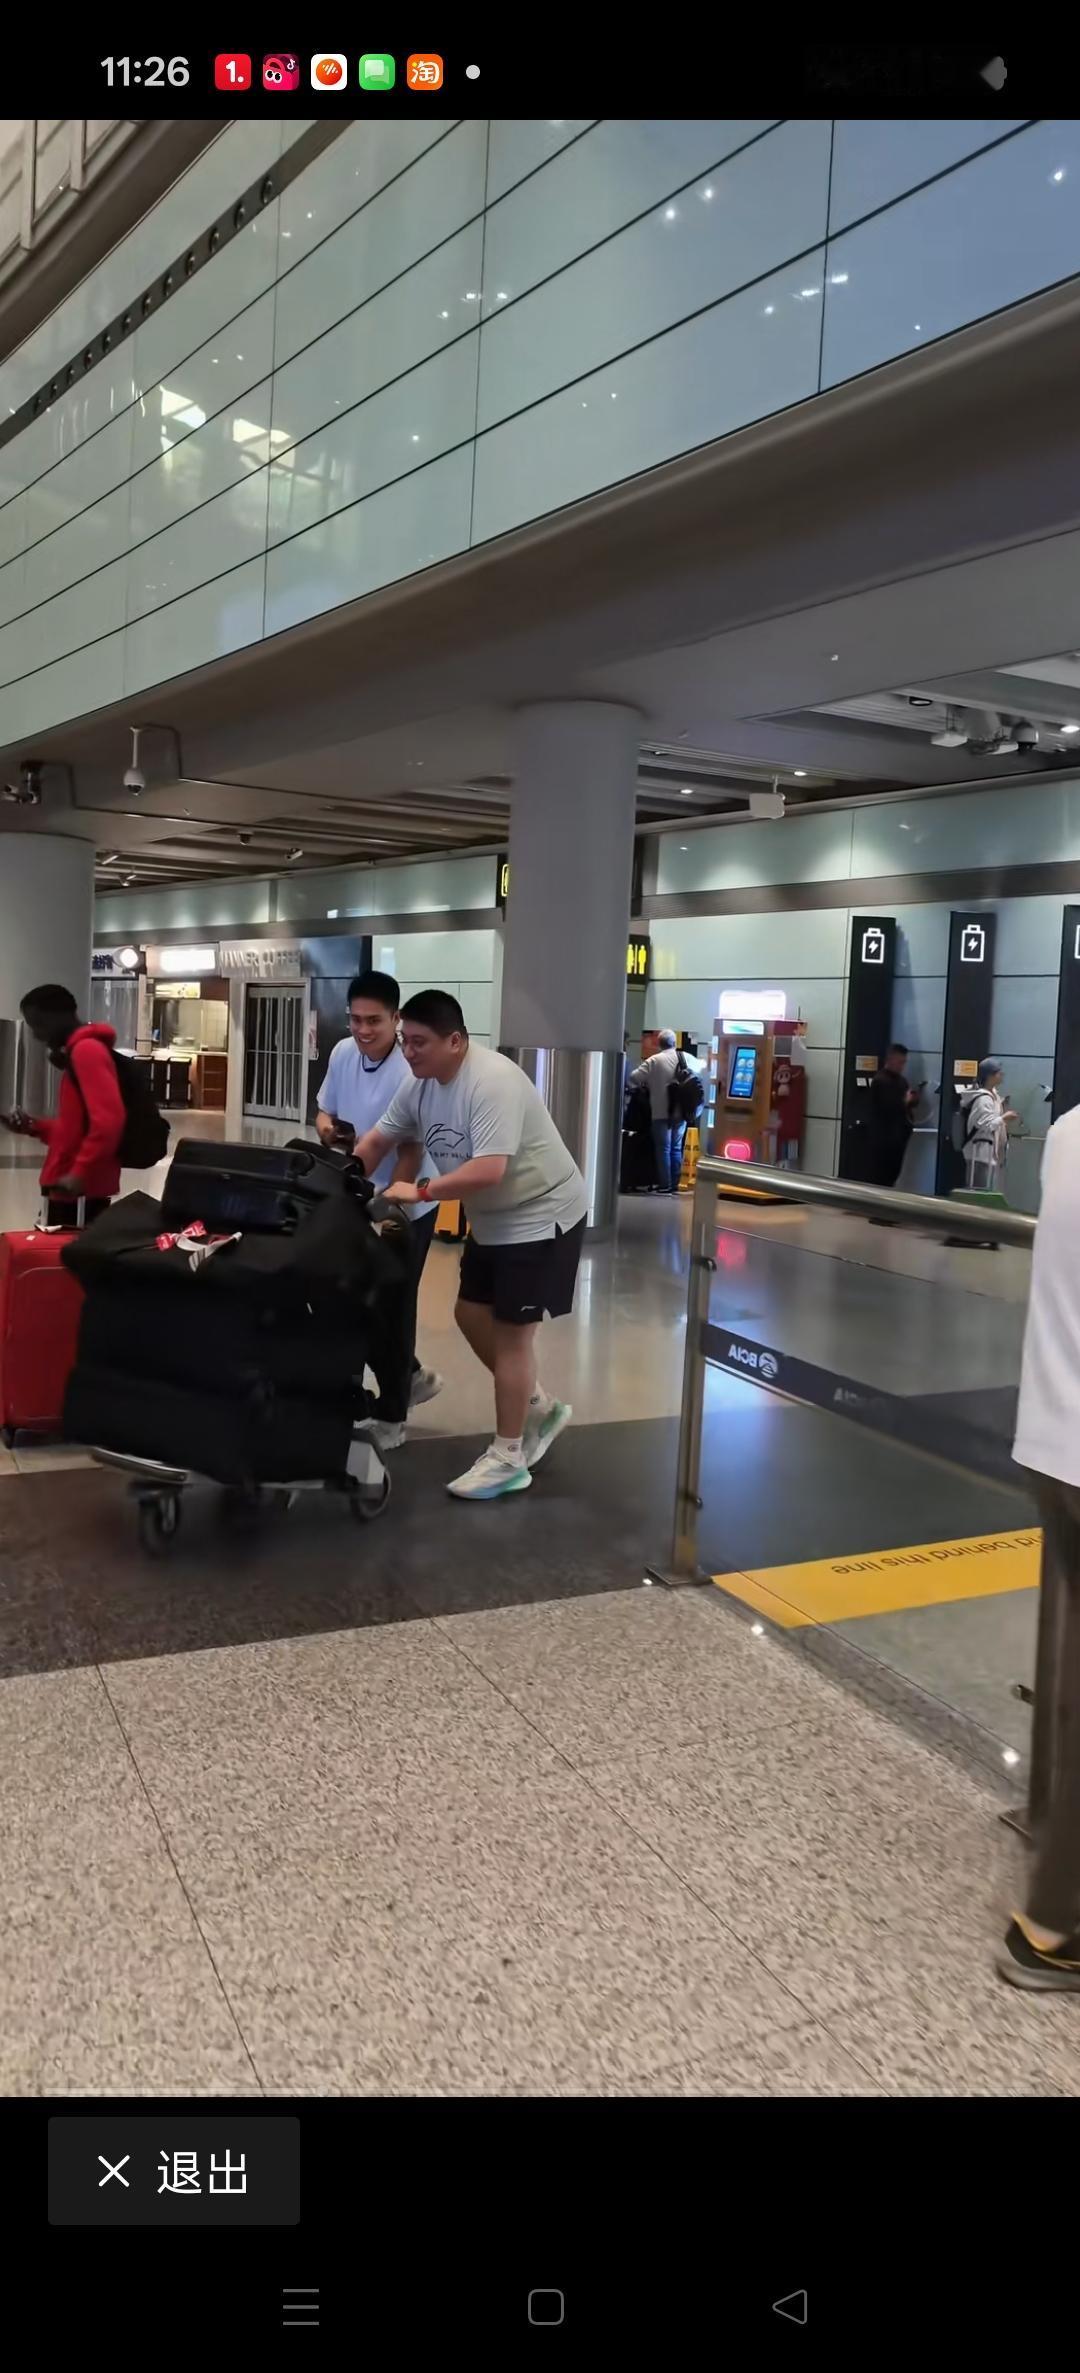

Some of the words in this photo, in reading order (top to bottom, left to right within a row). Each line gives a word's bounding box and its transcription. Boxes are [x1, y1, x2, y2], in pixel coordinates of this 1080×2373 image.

[931, 1541, 1014, 1561] behind
[880, 1554, 931, 1567] this
[831, 1561, 884, 1575] line
